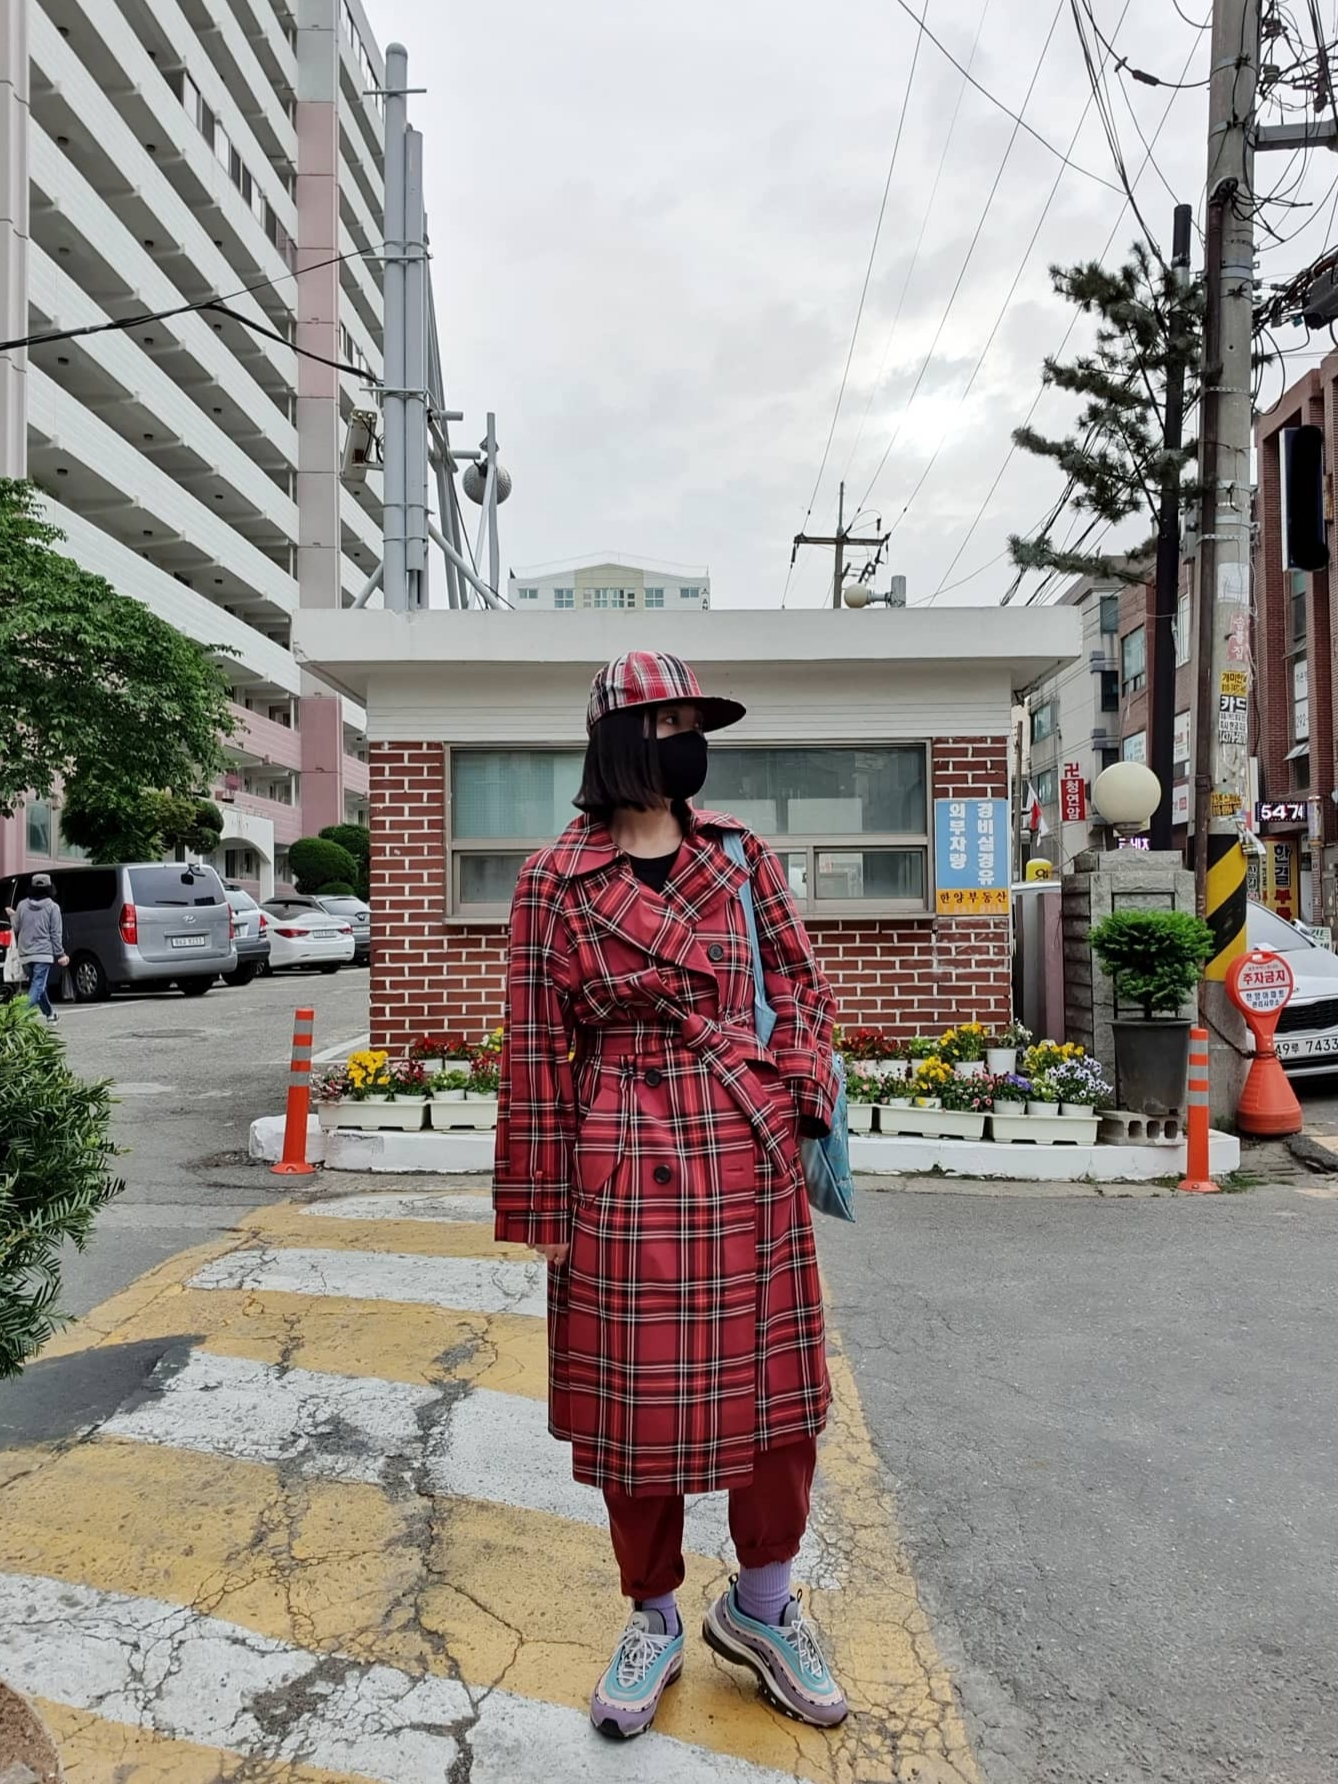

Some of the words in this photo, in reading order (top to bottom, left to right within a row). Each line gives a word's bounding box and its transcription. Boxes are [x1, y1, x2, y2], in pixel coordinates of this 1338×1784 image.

[1066, 780, 1081, 820] 청연암
[949, 802, 967, 870] 외부차량
[977, 802, 995, 886] 경비실경유
[940, 891, 1007, 904] 한양부동산
[1305, 1038, 1338, 1052] 7433
